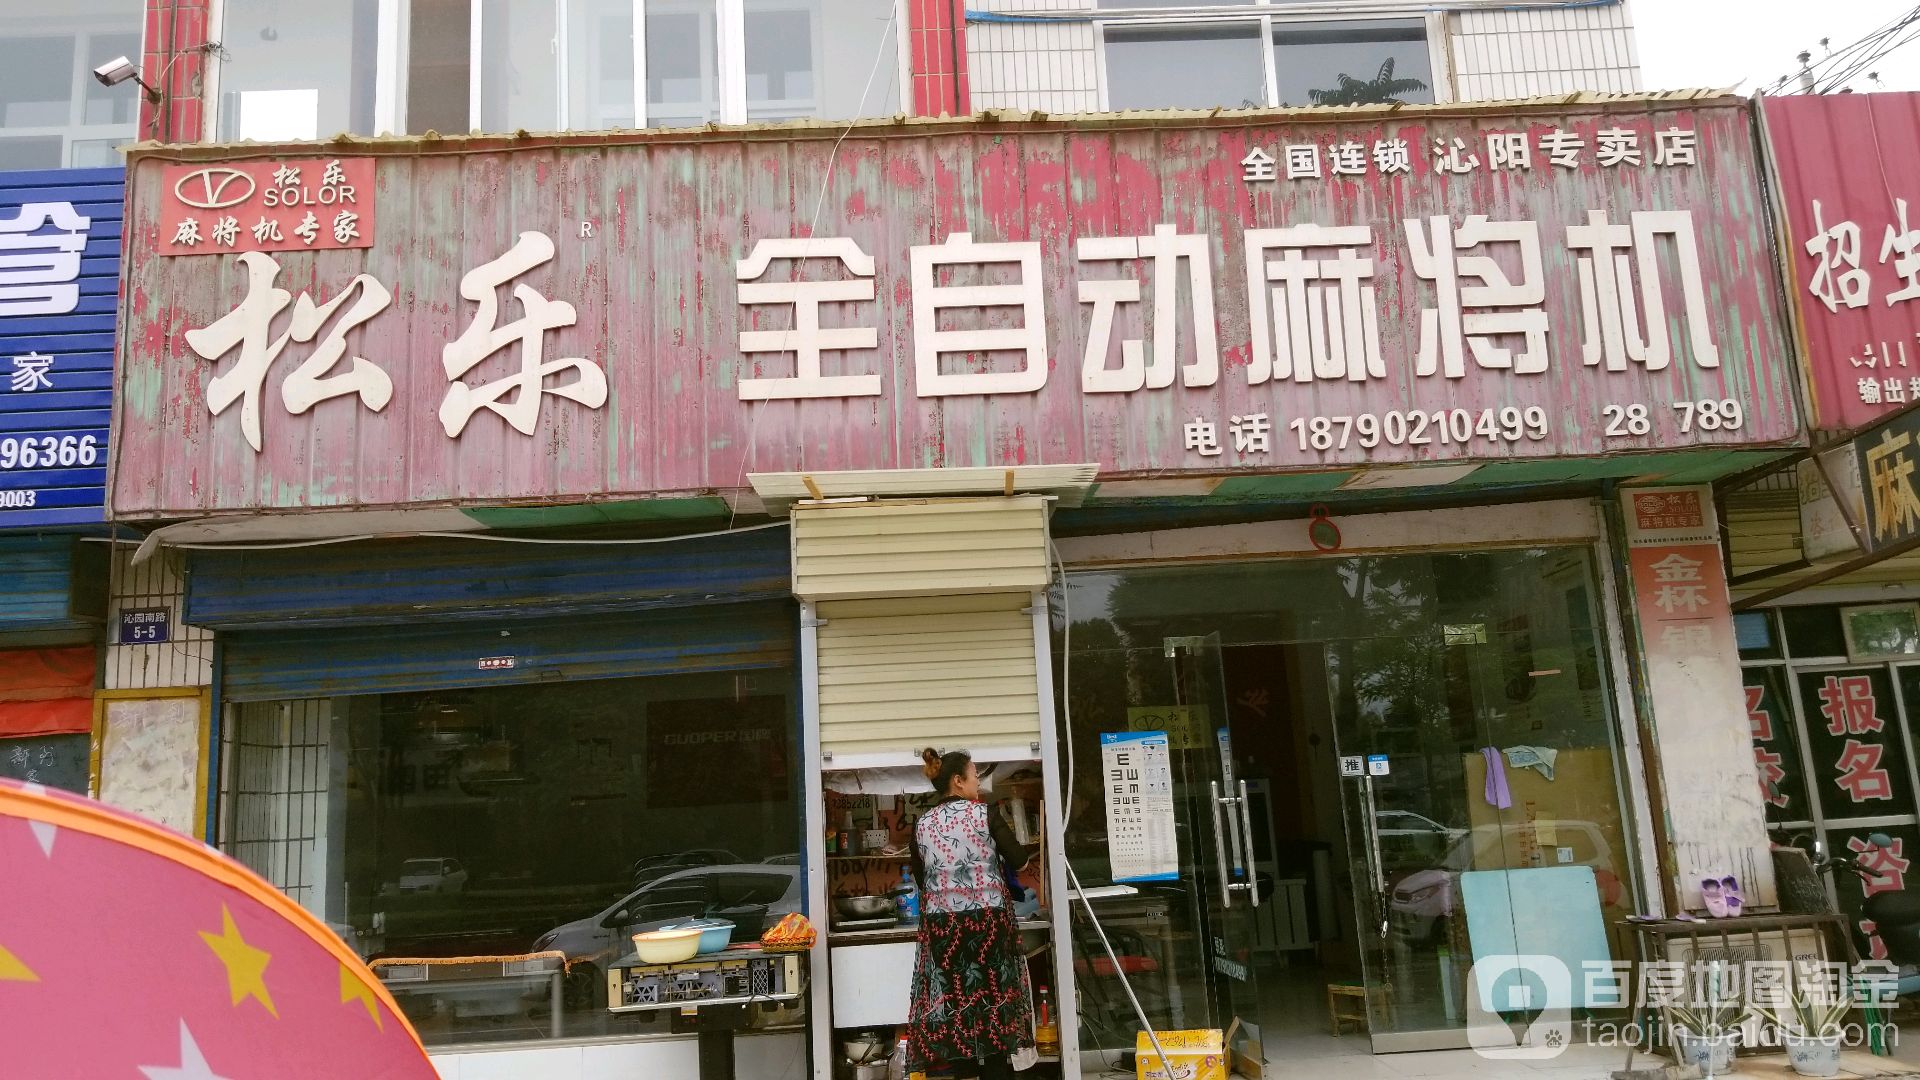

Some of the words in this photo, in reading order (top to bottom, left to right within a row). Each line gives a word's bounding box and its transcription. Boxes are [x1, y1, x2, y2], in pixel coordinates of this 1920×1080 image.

[1241, 138, 1411, 183] 全国连锁
[1433, 126, 1697, 175] 沁阳专卖店
[272, 159, 347, 189] 松乐
[263, 185, 356, 207] SOLOR
[170, 209, 361, 247] 麻将机专家
[581, 221, 592, 238] R
[1804, 197, 1920, 314] 招生
[184, 230, 609, 453] 松乐
[736, 209, 1719, 401] 全自动麻将机
[1183, 412, 1271, 457] 电话
[1291, 405, 1549, 451] 18790210499
[1603, 403, 1651, 436] 28
[1674, 398, 1744, 432] 789
[0, 434, 97, 469] 96366
[1866, 428, 1920, 543] 麻
[1649, 553, 1711, 614] 金杯
[123, 611, 166, 624] 沁园南路
[134, 625, 156, 639] 5-5
[1818, 675, 1893, 803] 报名
[1344, 759, 1360, 772] 推
